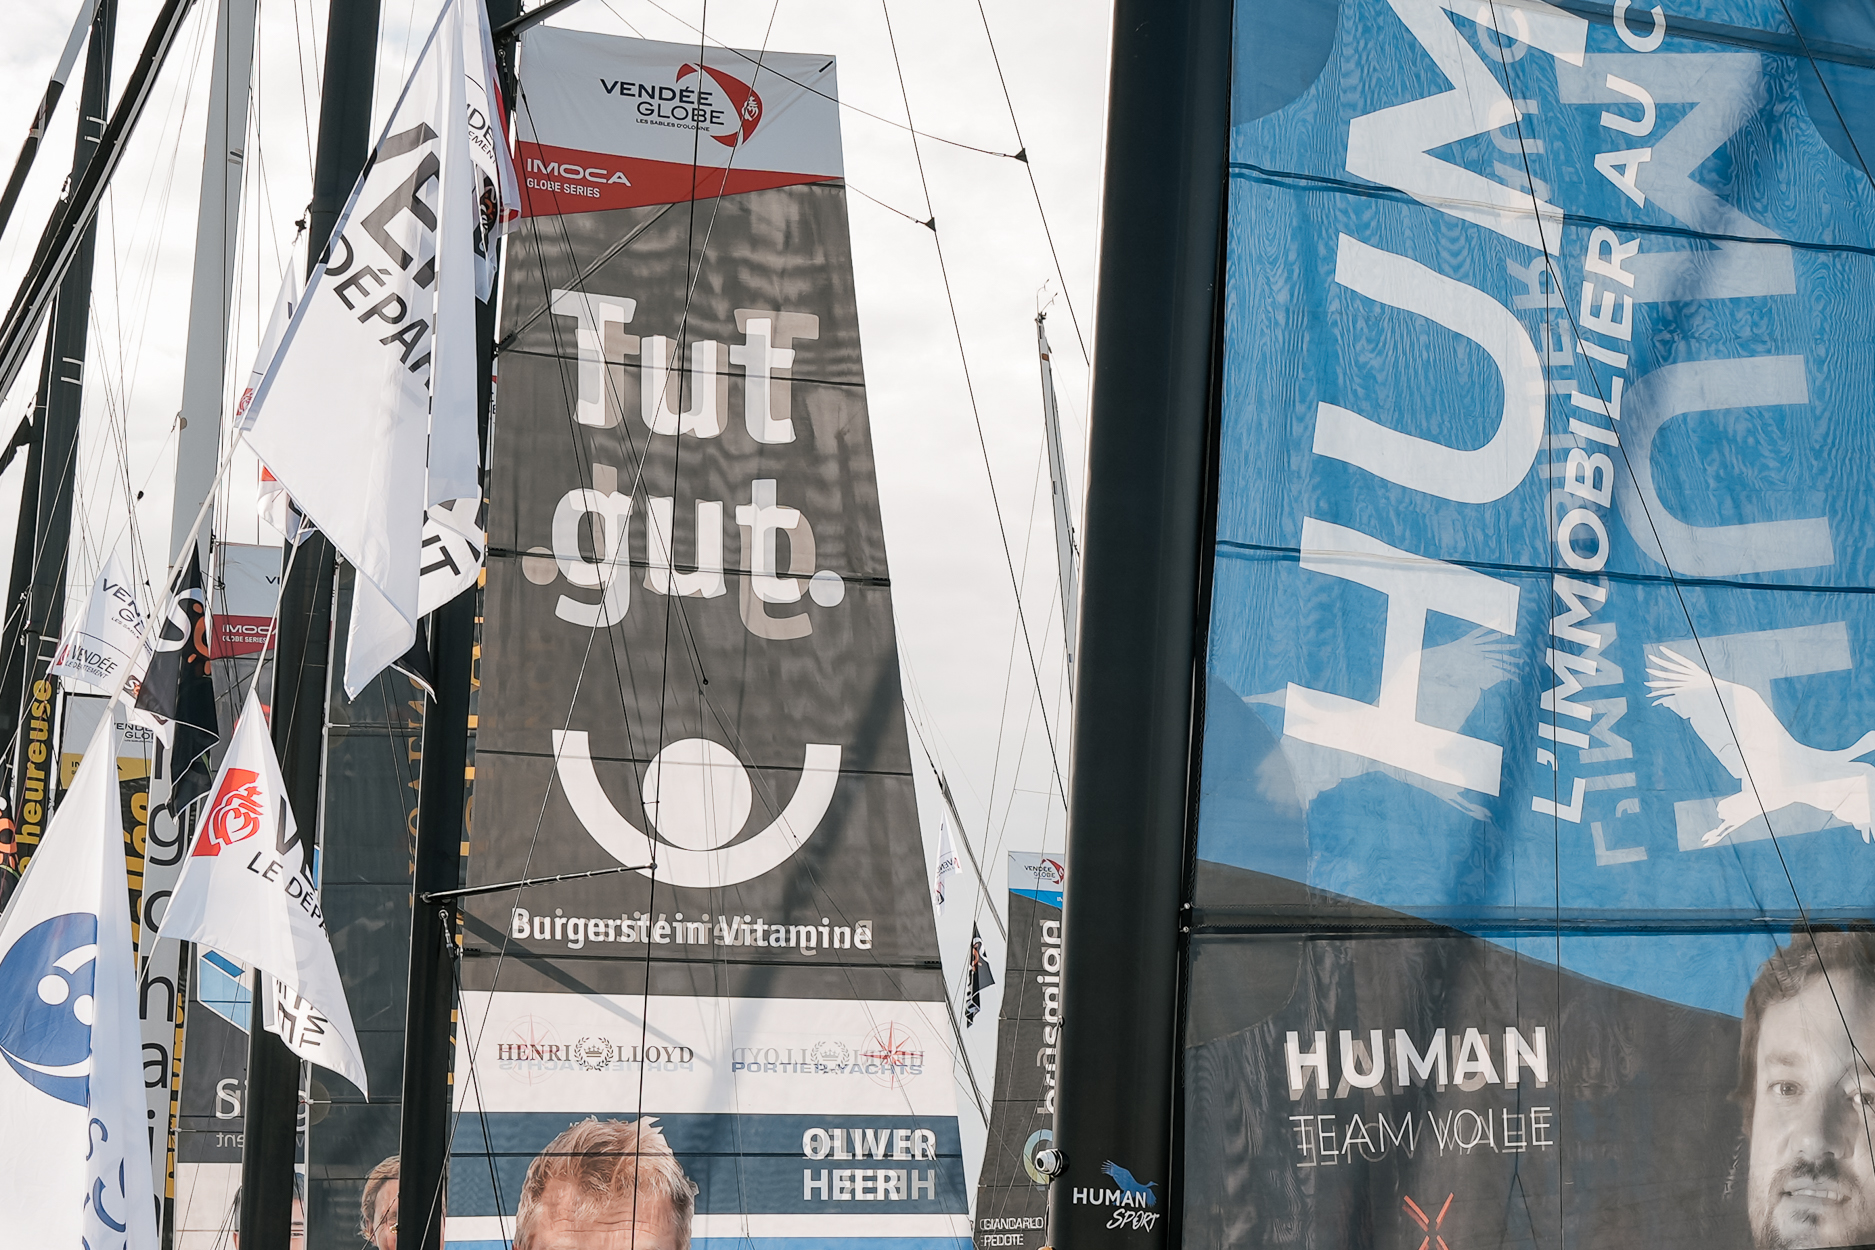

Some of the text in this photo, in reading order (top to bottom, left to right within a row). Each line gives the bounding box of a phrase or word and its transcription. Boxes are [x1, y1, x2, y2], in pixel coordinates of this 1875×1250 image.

[600, 78, 713, 107] VENDÉE
[636, 101, 725, 126] GLOBE
[636, 118, 650, 126] LES
[650, 119, 675, 129] SABLES
[526, 158, 632, 187] IMOCA
[526, 178, 601, 198] GLOBE SERIES
[552, 288, 797, 446] Tut
[1531, 75, 1657, 824] L'IMMOBILIER AU
[16, 679, 53, 846] heureuse
[512, 907, 873, 951] Burgerstein Vitamine
[497, 1043, 694, 1065] HENRI LLOYD
[1285, 1026, 1549, 1094] HUMAN
[802, 1128, 936, 1160] OLIVER
[1289, 1106, 1555, 1156] TEAM VOILE
[804, 1169, 900, 1201] HEER
[1073, 1187, 1147, 1209] HUMAN
[984, 1216, 1044, 1231] GIANCARLO
[1106, 1208, 1160, 1233] SPORT
[983, 1233, 1024, 1247] PEDOTE
